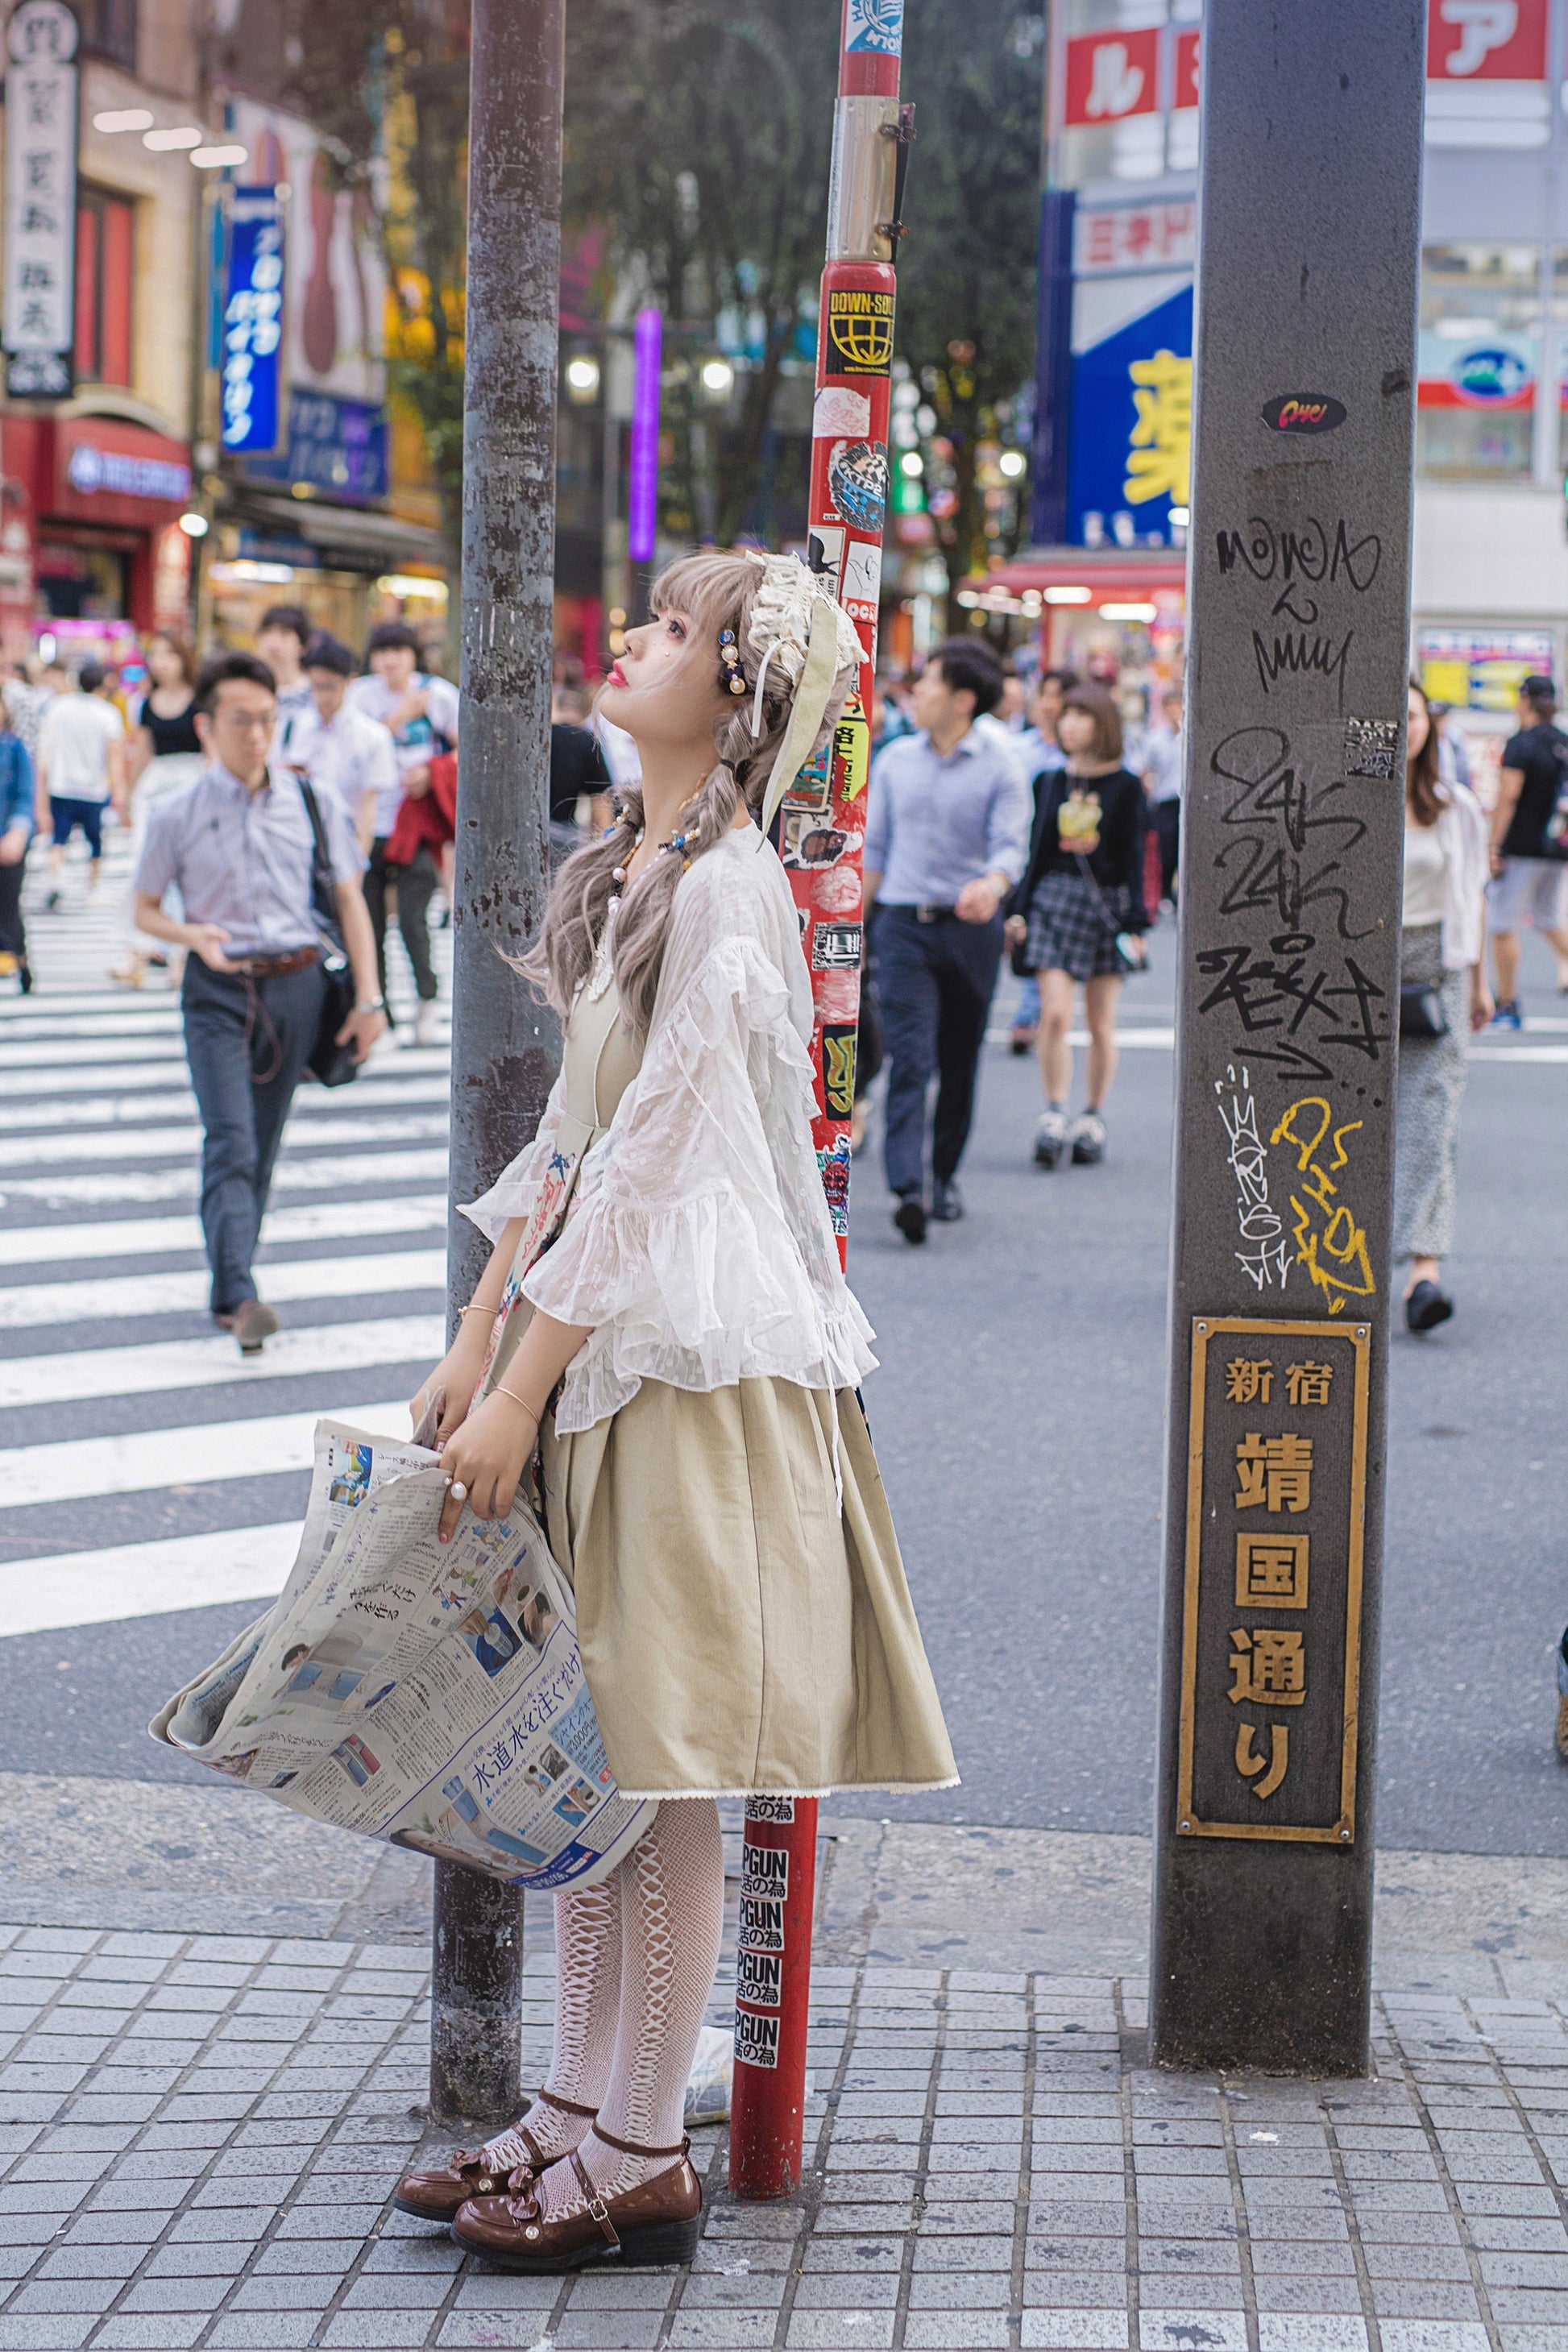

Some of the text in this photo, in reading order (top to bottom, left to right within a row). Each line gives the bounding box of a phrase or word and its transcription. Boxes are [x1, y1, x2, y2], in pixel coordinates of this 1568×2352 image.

[1226, 1358, 1334, 1406] 新宿
[1226, 1433, 1314, 1800] 靖国通り
